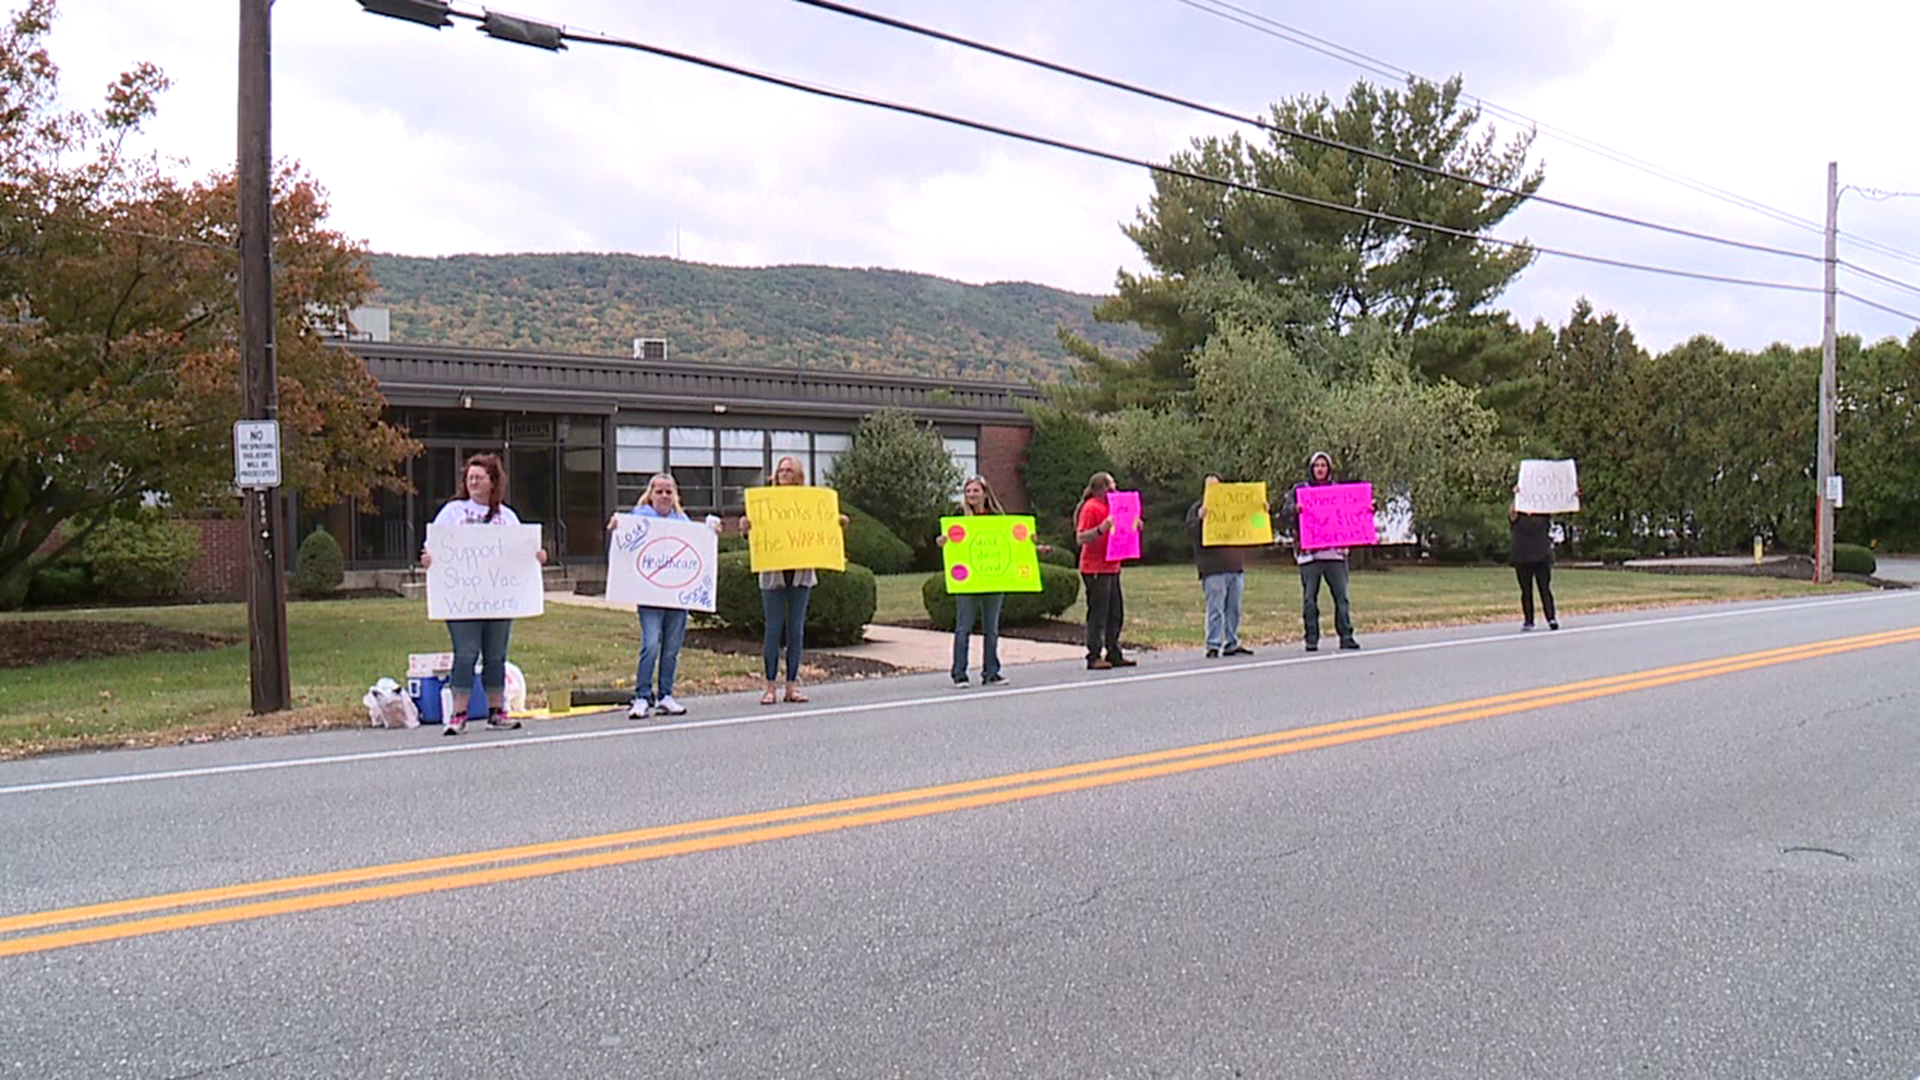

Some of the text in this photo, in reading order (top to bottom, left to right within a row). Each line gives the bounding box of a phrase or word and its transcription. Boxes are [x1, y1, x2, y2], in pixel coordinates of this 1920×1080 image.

[250, 430, 264, 441] NO
[750, 498, 812, 521] Thanks
[439, 532, 506, 571] Support
[751, 530, 784, 554] the
[642, 553, 698, 570] Healthcare
[444, 567, 519, 594] Shop Vac
[444, 595, 519, 615] Workers
